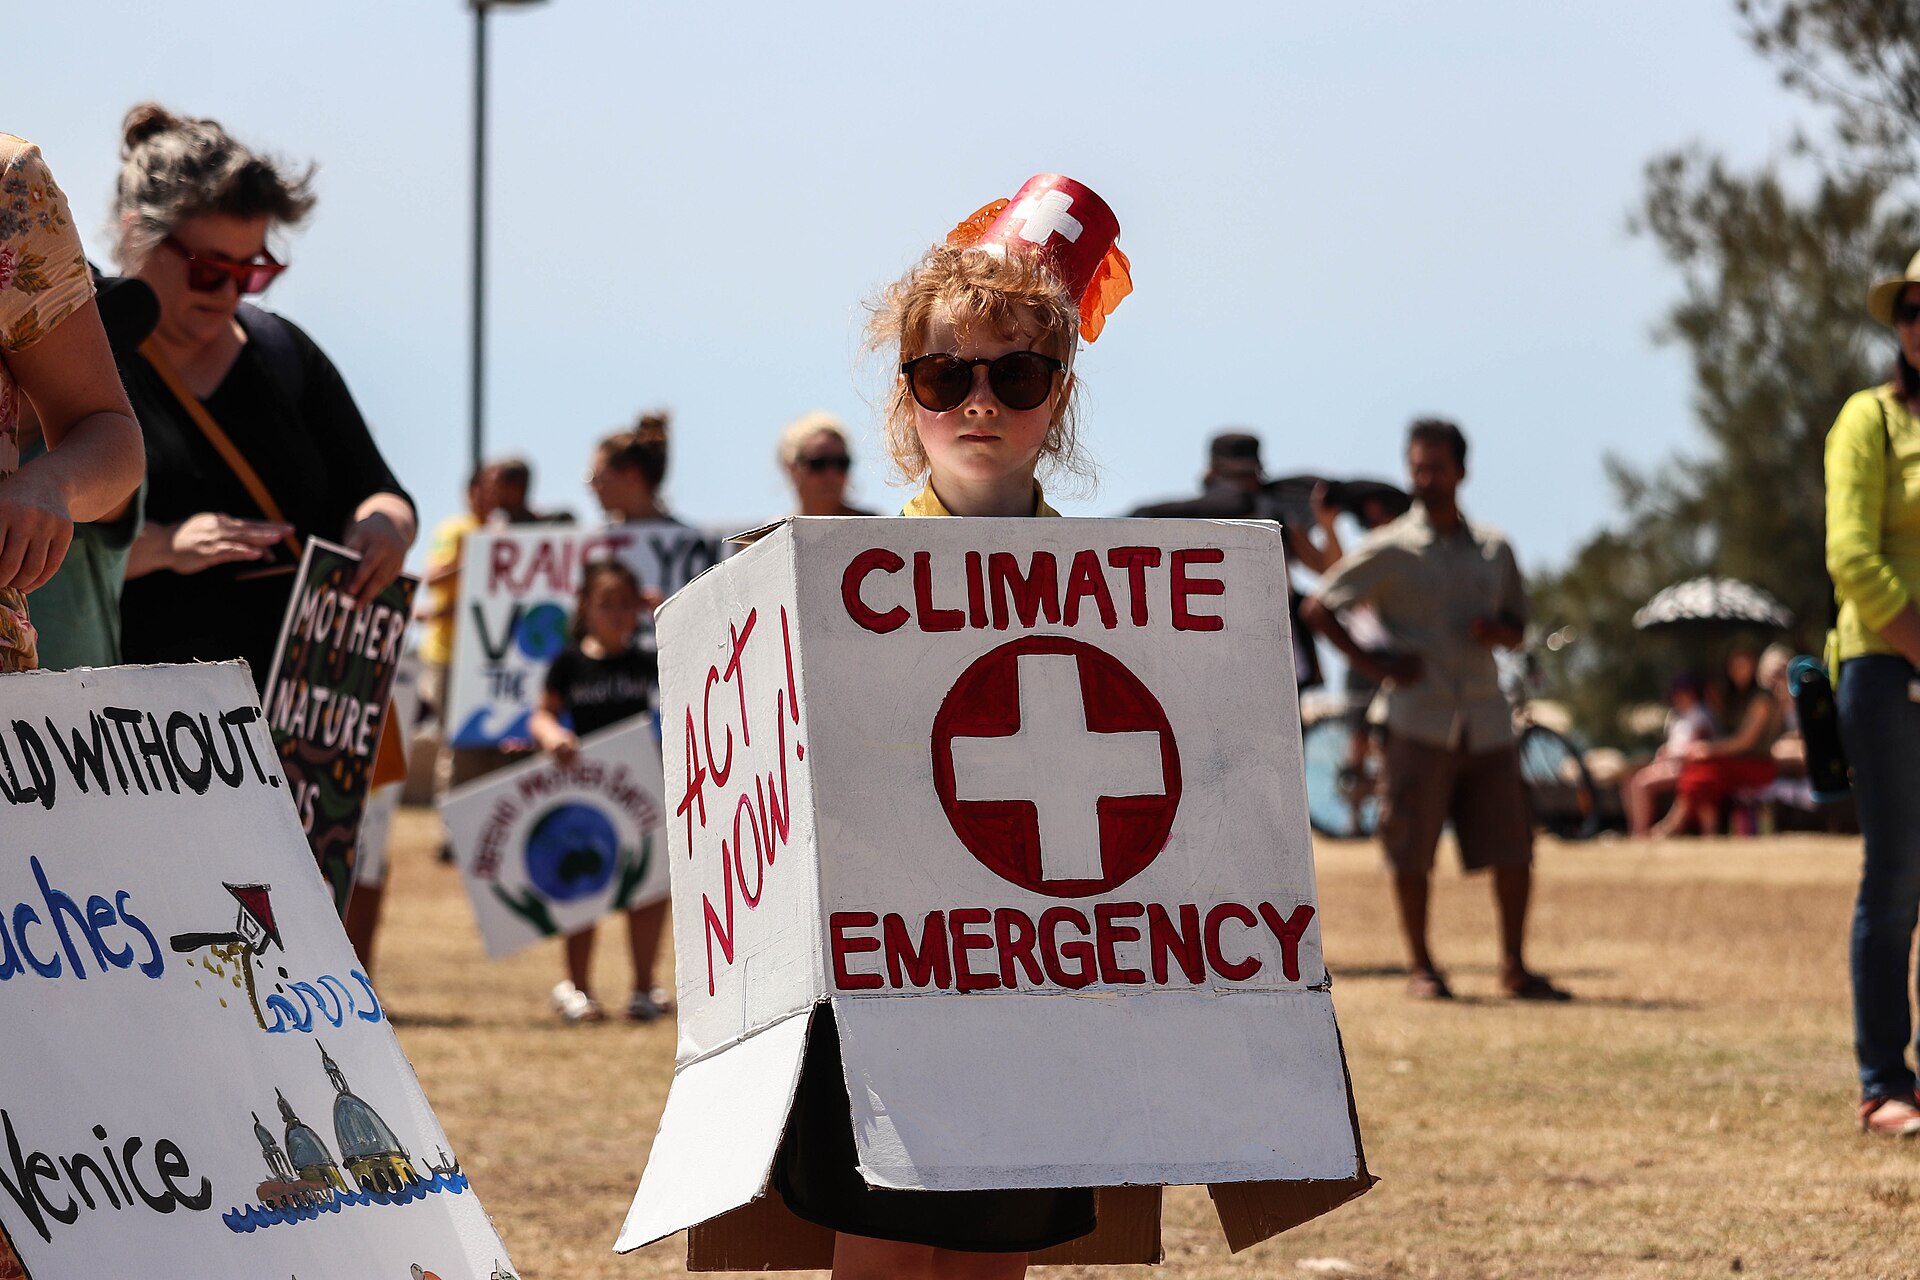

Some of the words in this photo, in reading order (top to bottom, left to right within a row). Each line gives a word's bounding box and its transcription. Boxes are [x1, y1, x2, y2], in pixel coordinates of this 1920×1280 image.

[487, 537, 632, 596] RAI
[841, 547, 1225, 634] CLIMATE
[291, 585, 405, 665] MOTHER
[271, 678, 380, 756] NATURE
[677, 607, 757, 860] ACT
[703, 604, 804, 996] NOW!
[829, 902, 1315, 993] EMERGENCY
[0, 1109, 212, 1243] Venice
